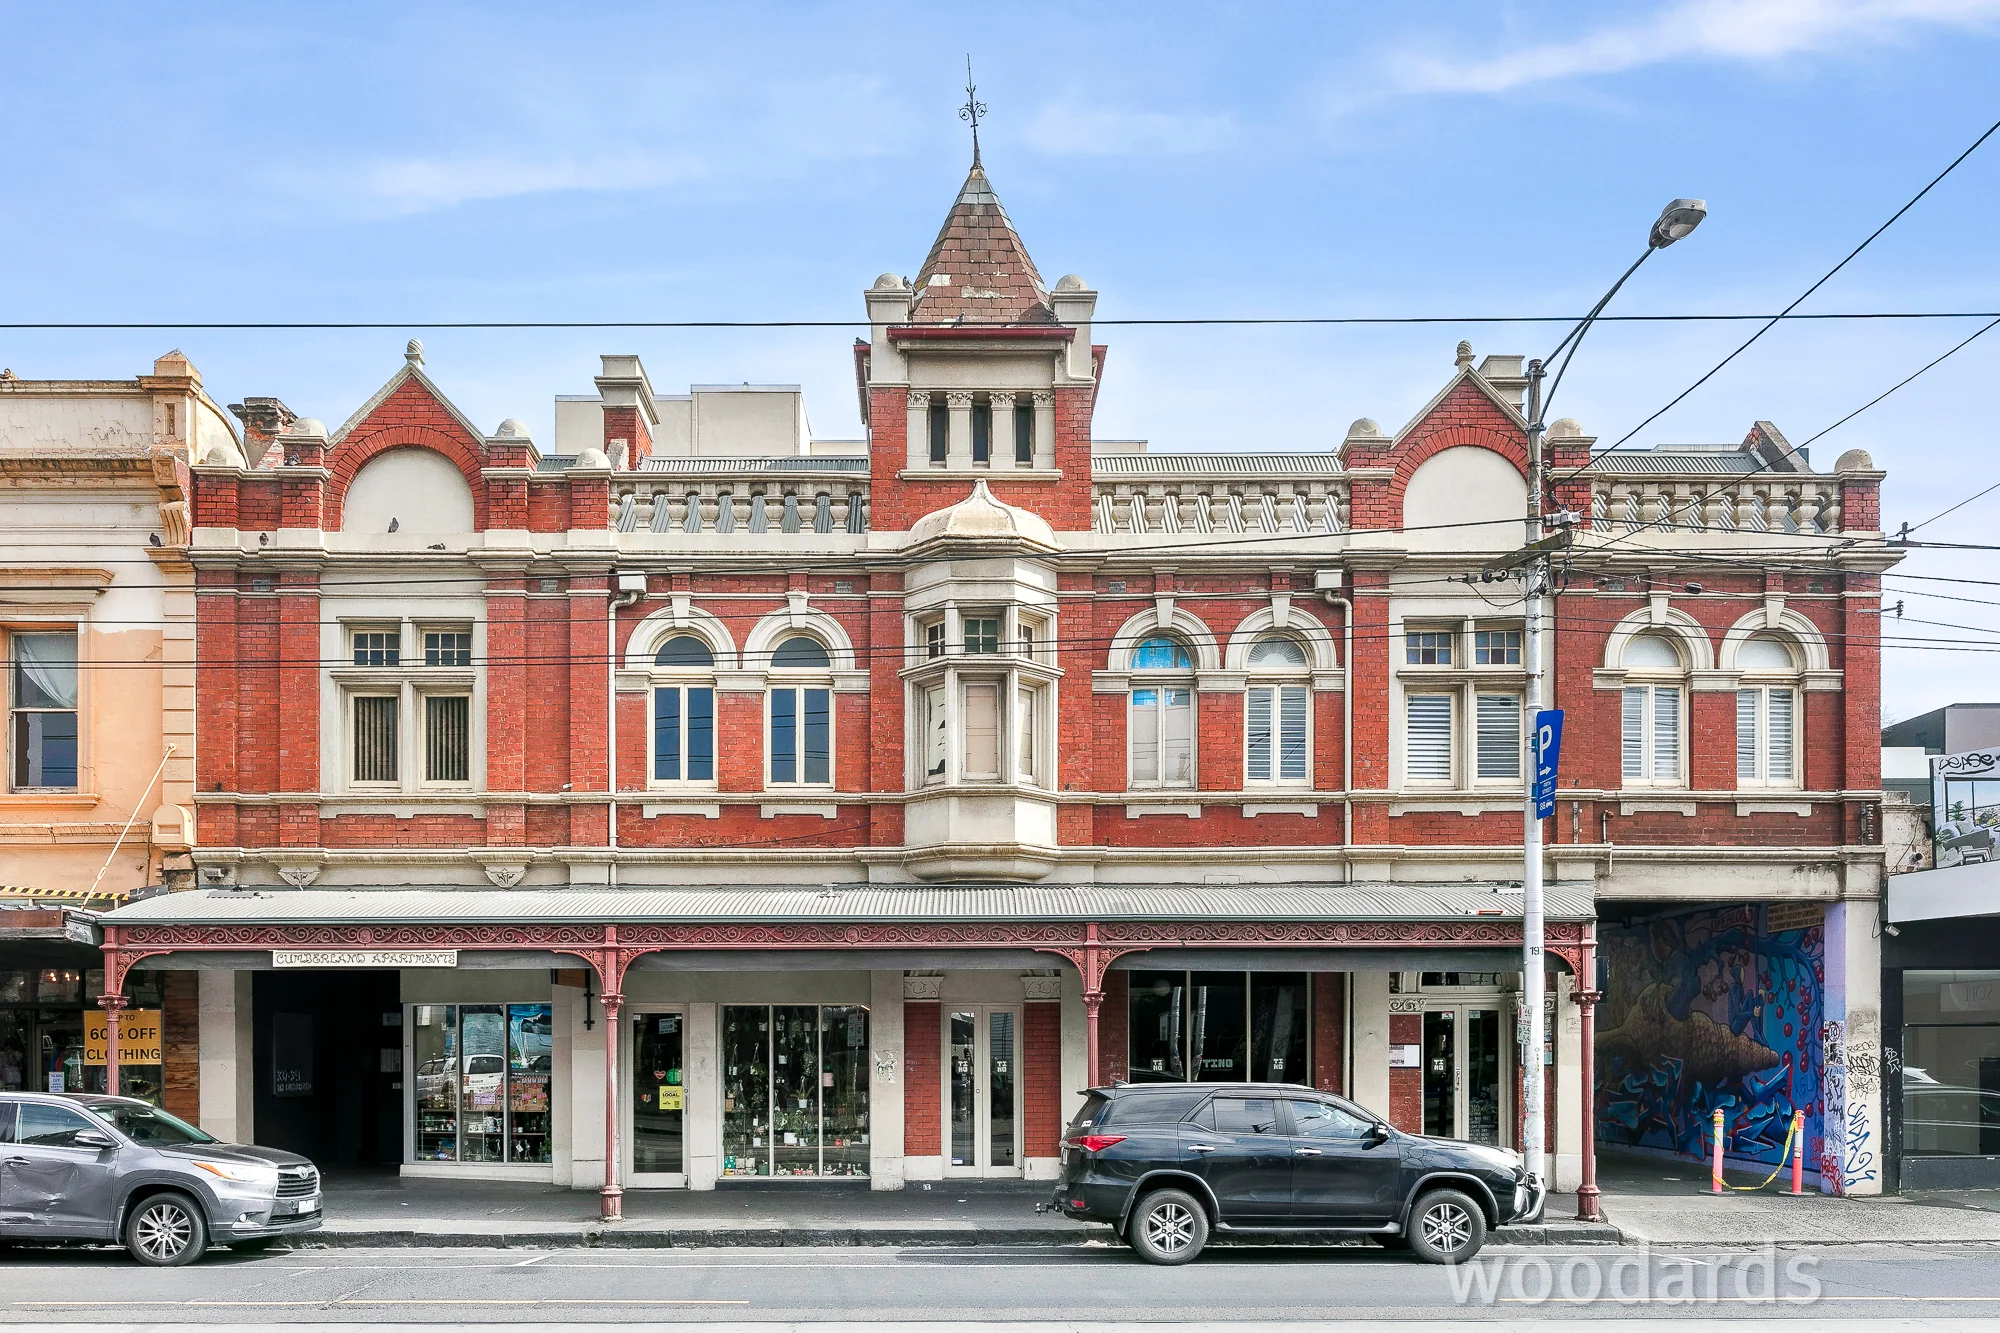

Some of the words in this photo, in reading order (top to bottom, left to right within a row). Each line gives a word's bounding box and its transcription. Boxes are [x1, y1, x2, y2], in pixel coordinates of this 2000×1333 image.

[1540, 725, 1552, 764] P
[276, 953, 365, 964] CUMBERLAND
[372, 953, 455, 964] APARTMENTS
[127, 1028, 157, 1040] OFF
[86, 1048, 160, 1060] CLTHING
[1203, 1058, 1233, 1068] TINO
